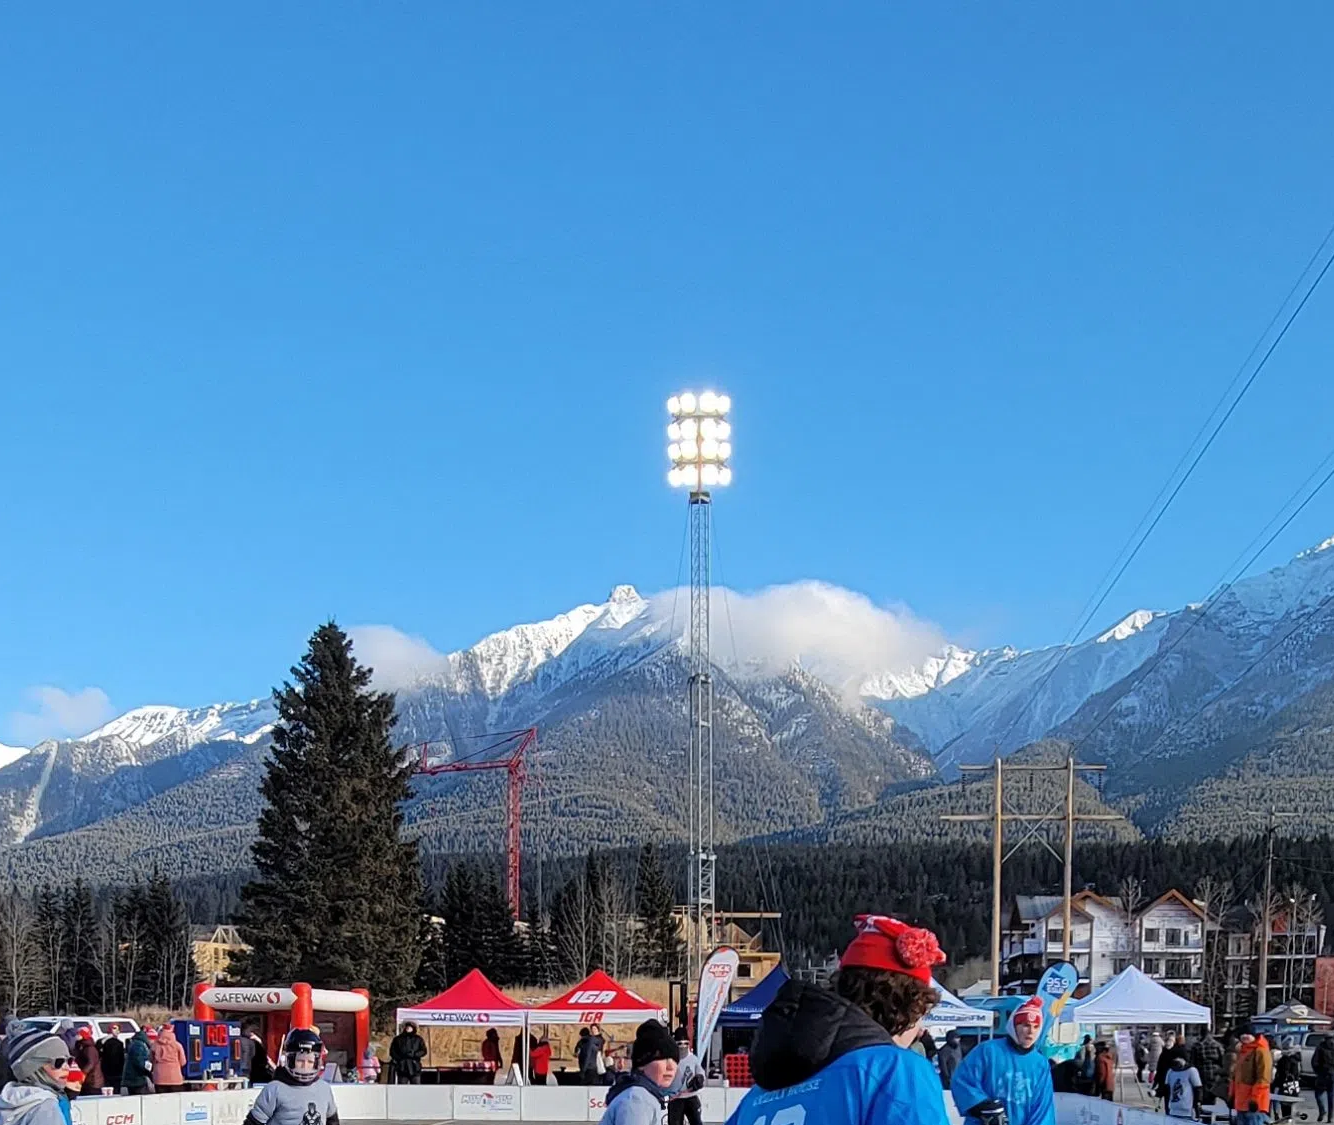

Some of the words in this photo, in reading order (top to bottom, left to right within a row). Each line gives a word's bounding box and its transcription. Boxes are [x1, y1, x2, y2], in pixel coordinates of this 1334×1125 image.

[214, 992, 265, 1004] SAFEWAY
[568, 990, 617, 1004] IGA
[430, 1012, 477, 1022] SAFEWAY
[578, 1011, 604, 1023] IGA
[589, 1097, 607, 1109] Sc
[106, 1113, 135, 1125] CCM
